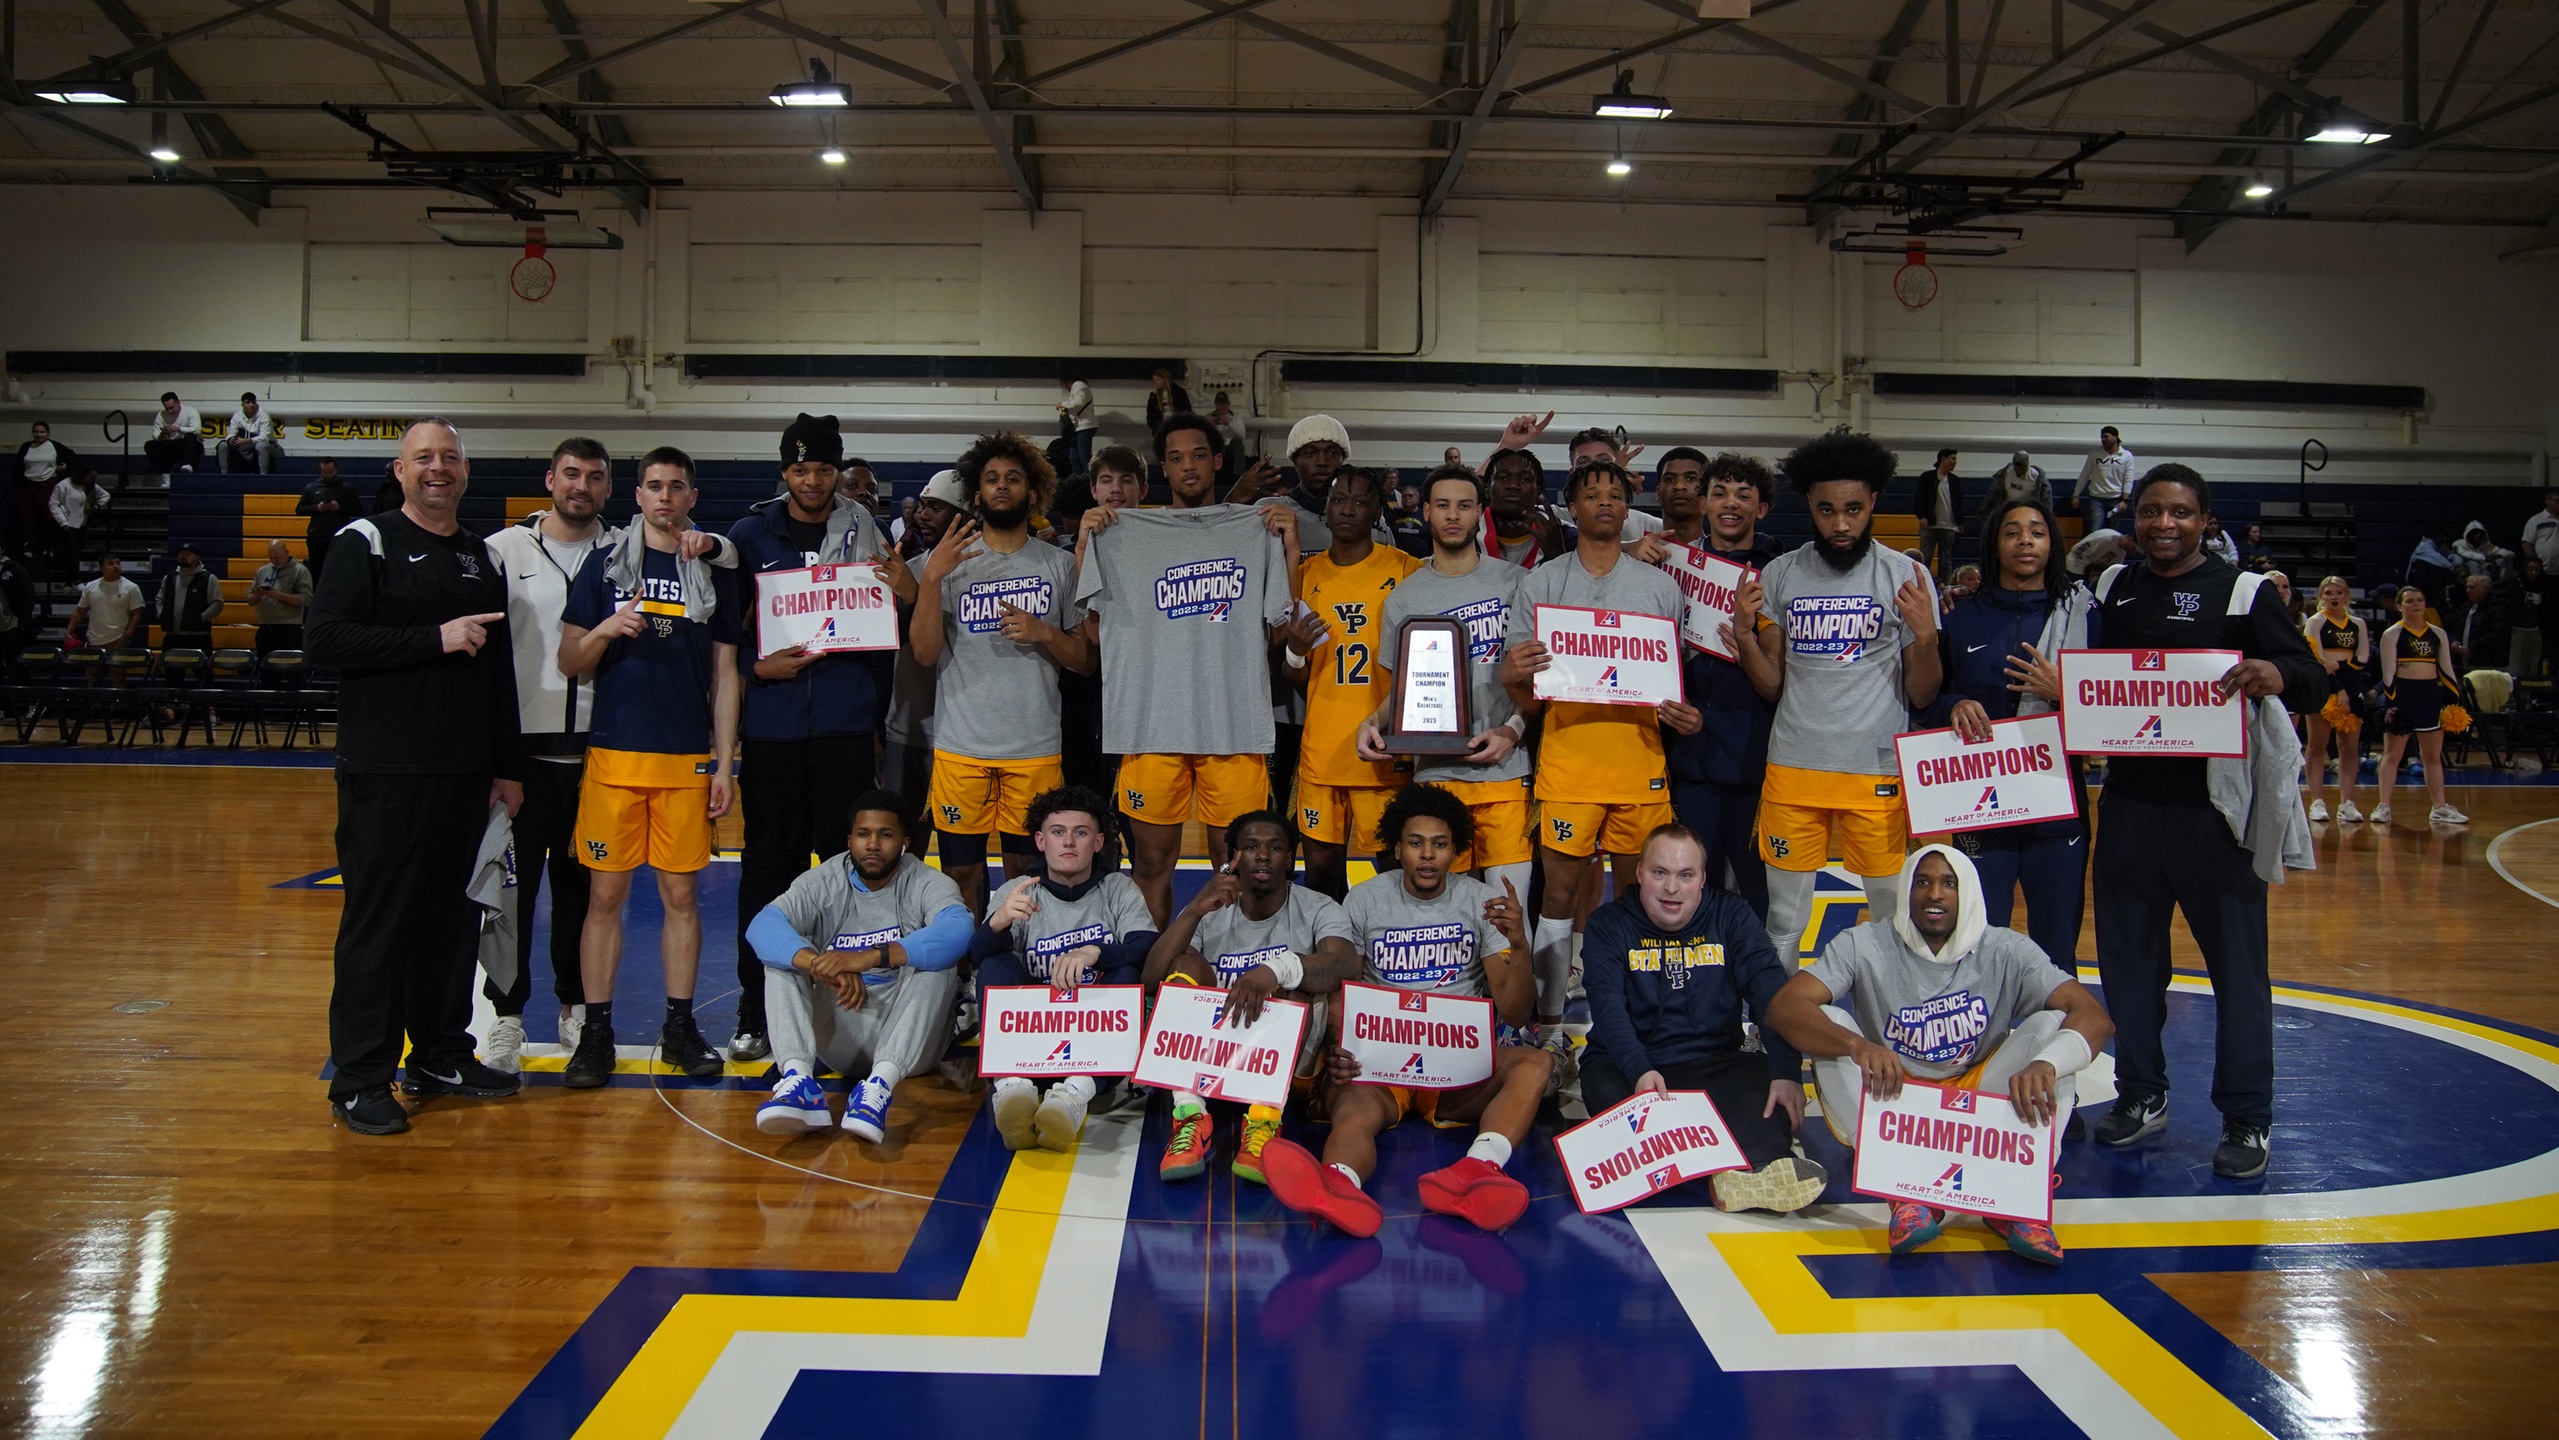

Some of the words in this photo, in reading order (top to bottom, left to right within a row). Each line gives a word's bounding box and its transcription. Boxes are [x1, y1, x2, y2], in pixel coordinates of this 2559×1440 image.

[305, 417, 411, 440] SEATIN
[1167, 560, 1234, 581] CONFERENCE
[972, 577, 1040, 596] CONFERENCE
[1157, 569, 1244, 609] CHAMPIONS
[772, 586, 883, 618] CHAMPIONS
[1172, 603, 1215, 616] 2022-23
[1793, 598, 1871, 612] CONFERENCE
[2173, 592, 2200, 616] WP
[1333, 603, 1368, 635] WP
[1786, 607, 1882, 640] CHAMPIONS
[1551, 630, 1668, 662] CHAMPIONS
[1796, 642, 1844, 650] 2022-23
[1336, 644, 1370, 686] 12
[2079, 680, 2227, 707] CHAMPIONS
[1916, 744, 2052, 786] CHAMPIONS
[1944, 814, 1974, 822] HEART
[1986, 808, 2030, 818] AMERICA
[1037, 926, 1102, 952] CONFERENCE
[1386, 925, 1462, 944] CONFERENCE
[1374, 934, 1473, 970] CHAMPIONS
[1387, 970, 1442, 980] 2022-23
[1194, 995, 1224, 1004] MERICA
[1000, 1010, 1128, 1032] CHAMPIONS
[1356, 1012, 1479, 1049] CHAMPIONS
[1886, 999, 1988, 1052] CHAMPIONS
[1154, 1030, 1279, 1076] CHAMPIONS
[1899, 1045, 1957, 1061] 2022-23
[1598, 1104, 1636, 1128] AMERICA
[1879, 1110, 2035, 1166] CHAMPIONS
[1584, 1126, 1719, 1190] CHAMPIONS
[1896, 1182, 1932, 1194] HEART
[1946, 1192, 1996, 1206] AMERICA
[1910, 1192, 1938, 1200] ATHLETIC
[1940, 1198, 1982, 1208] CONFERENCE
